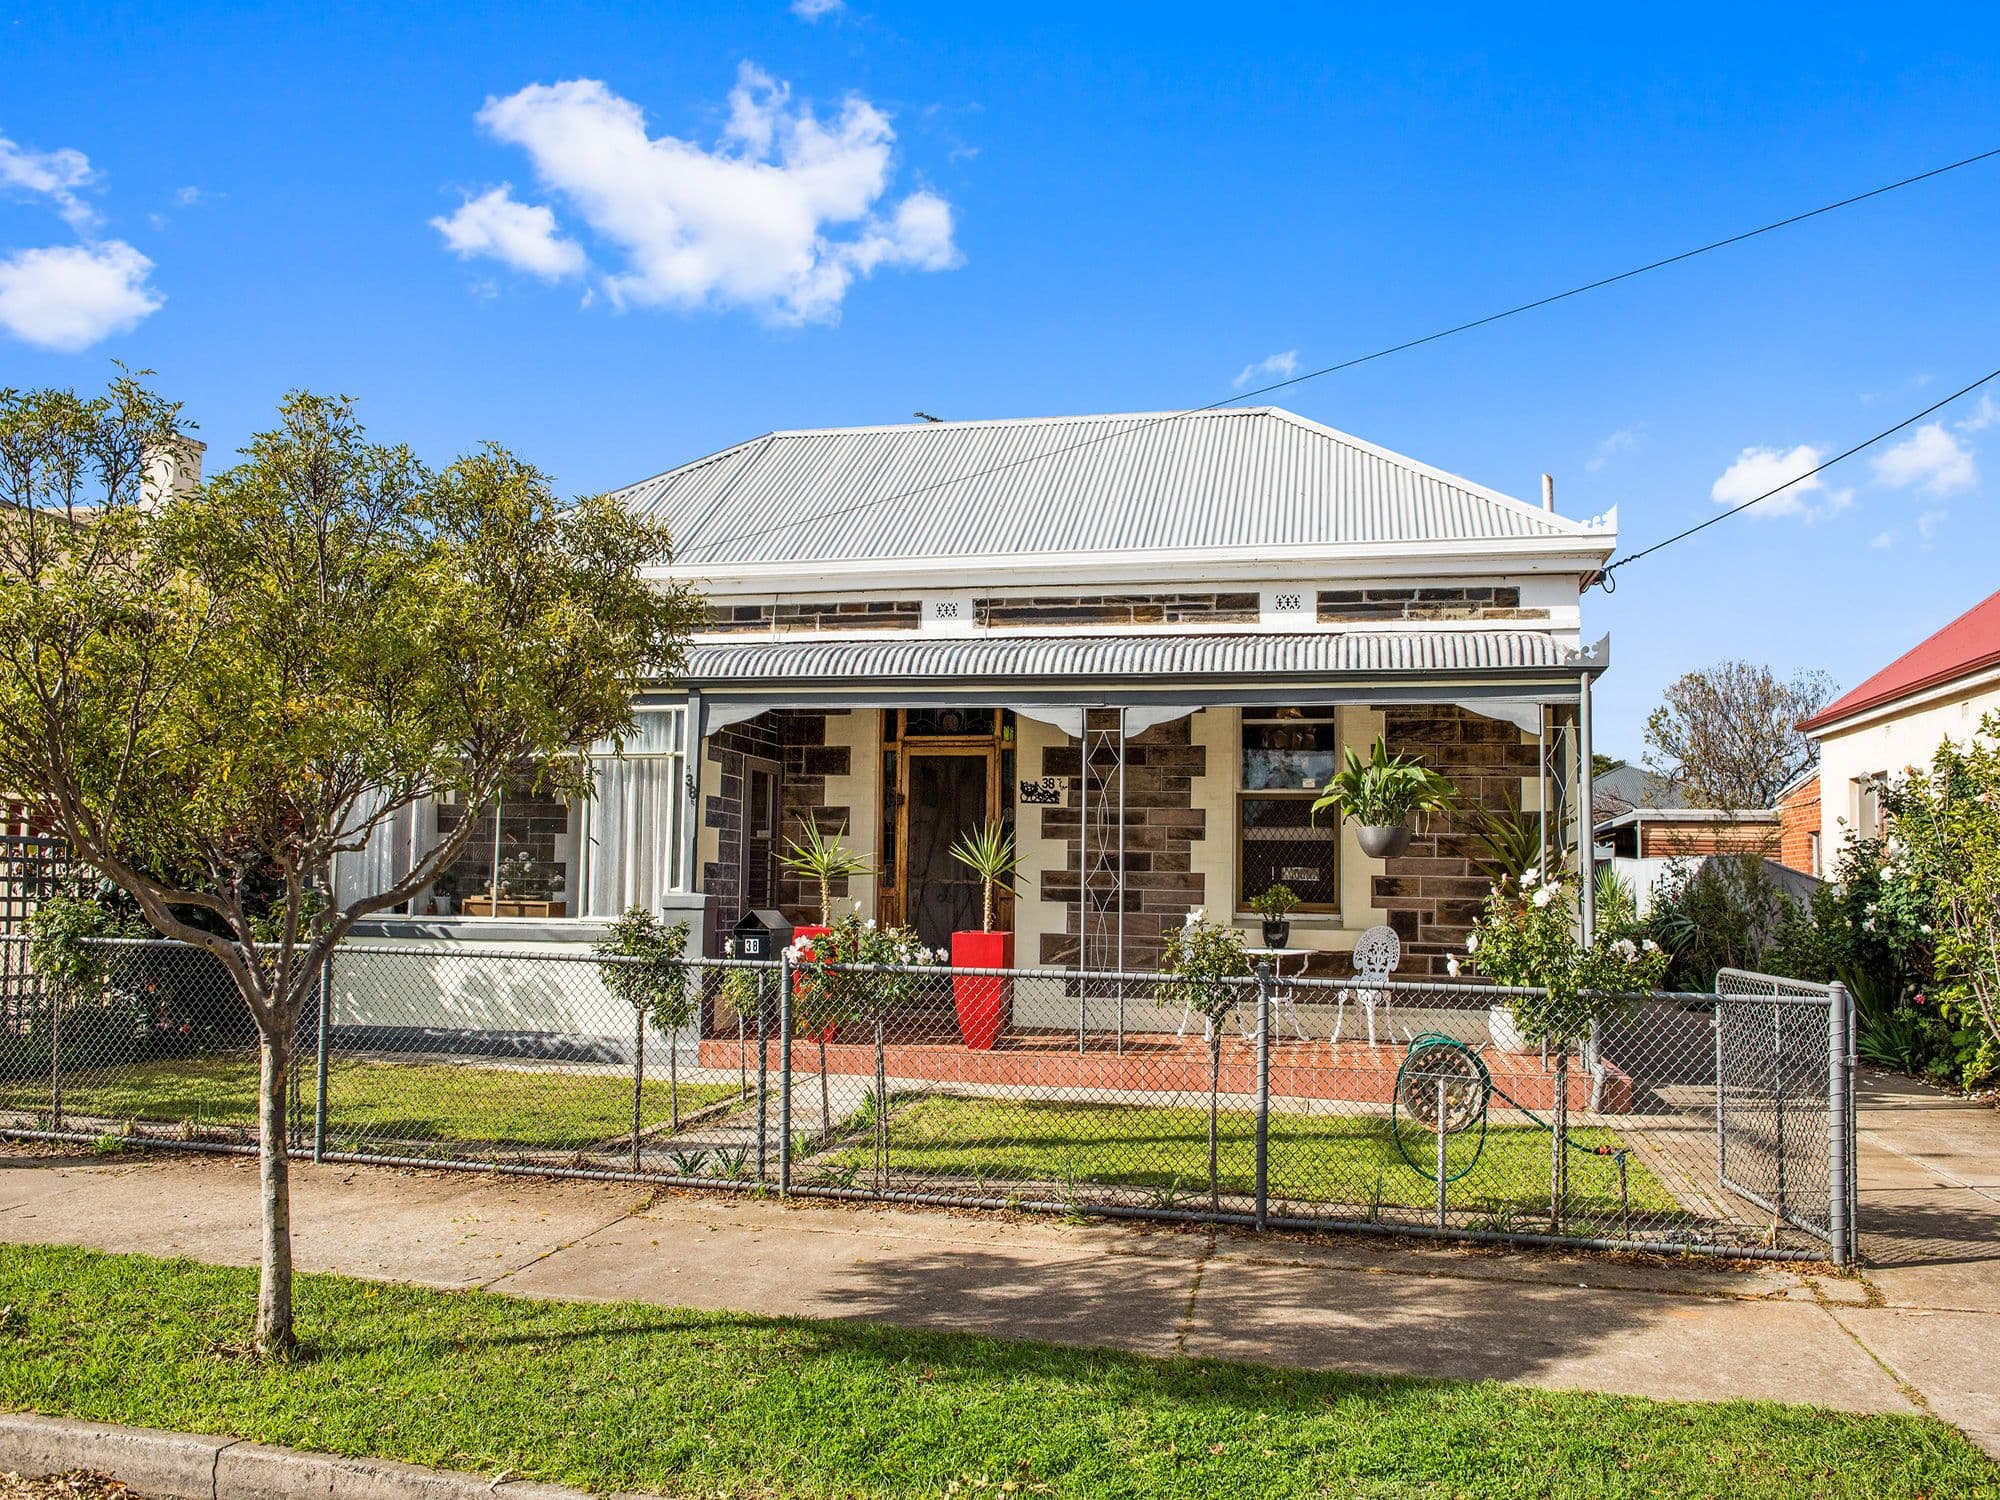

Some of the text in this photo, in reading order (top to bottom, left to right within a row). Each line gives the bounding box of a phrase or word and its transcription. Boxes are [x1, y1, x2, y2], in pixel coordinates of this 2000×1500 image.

[685, 774, 697, 799] 38
[1041, 777, 1055, 789] 38
[745, 940, 758, 952] 38
